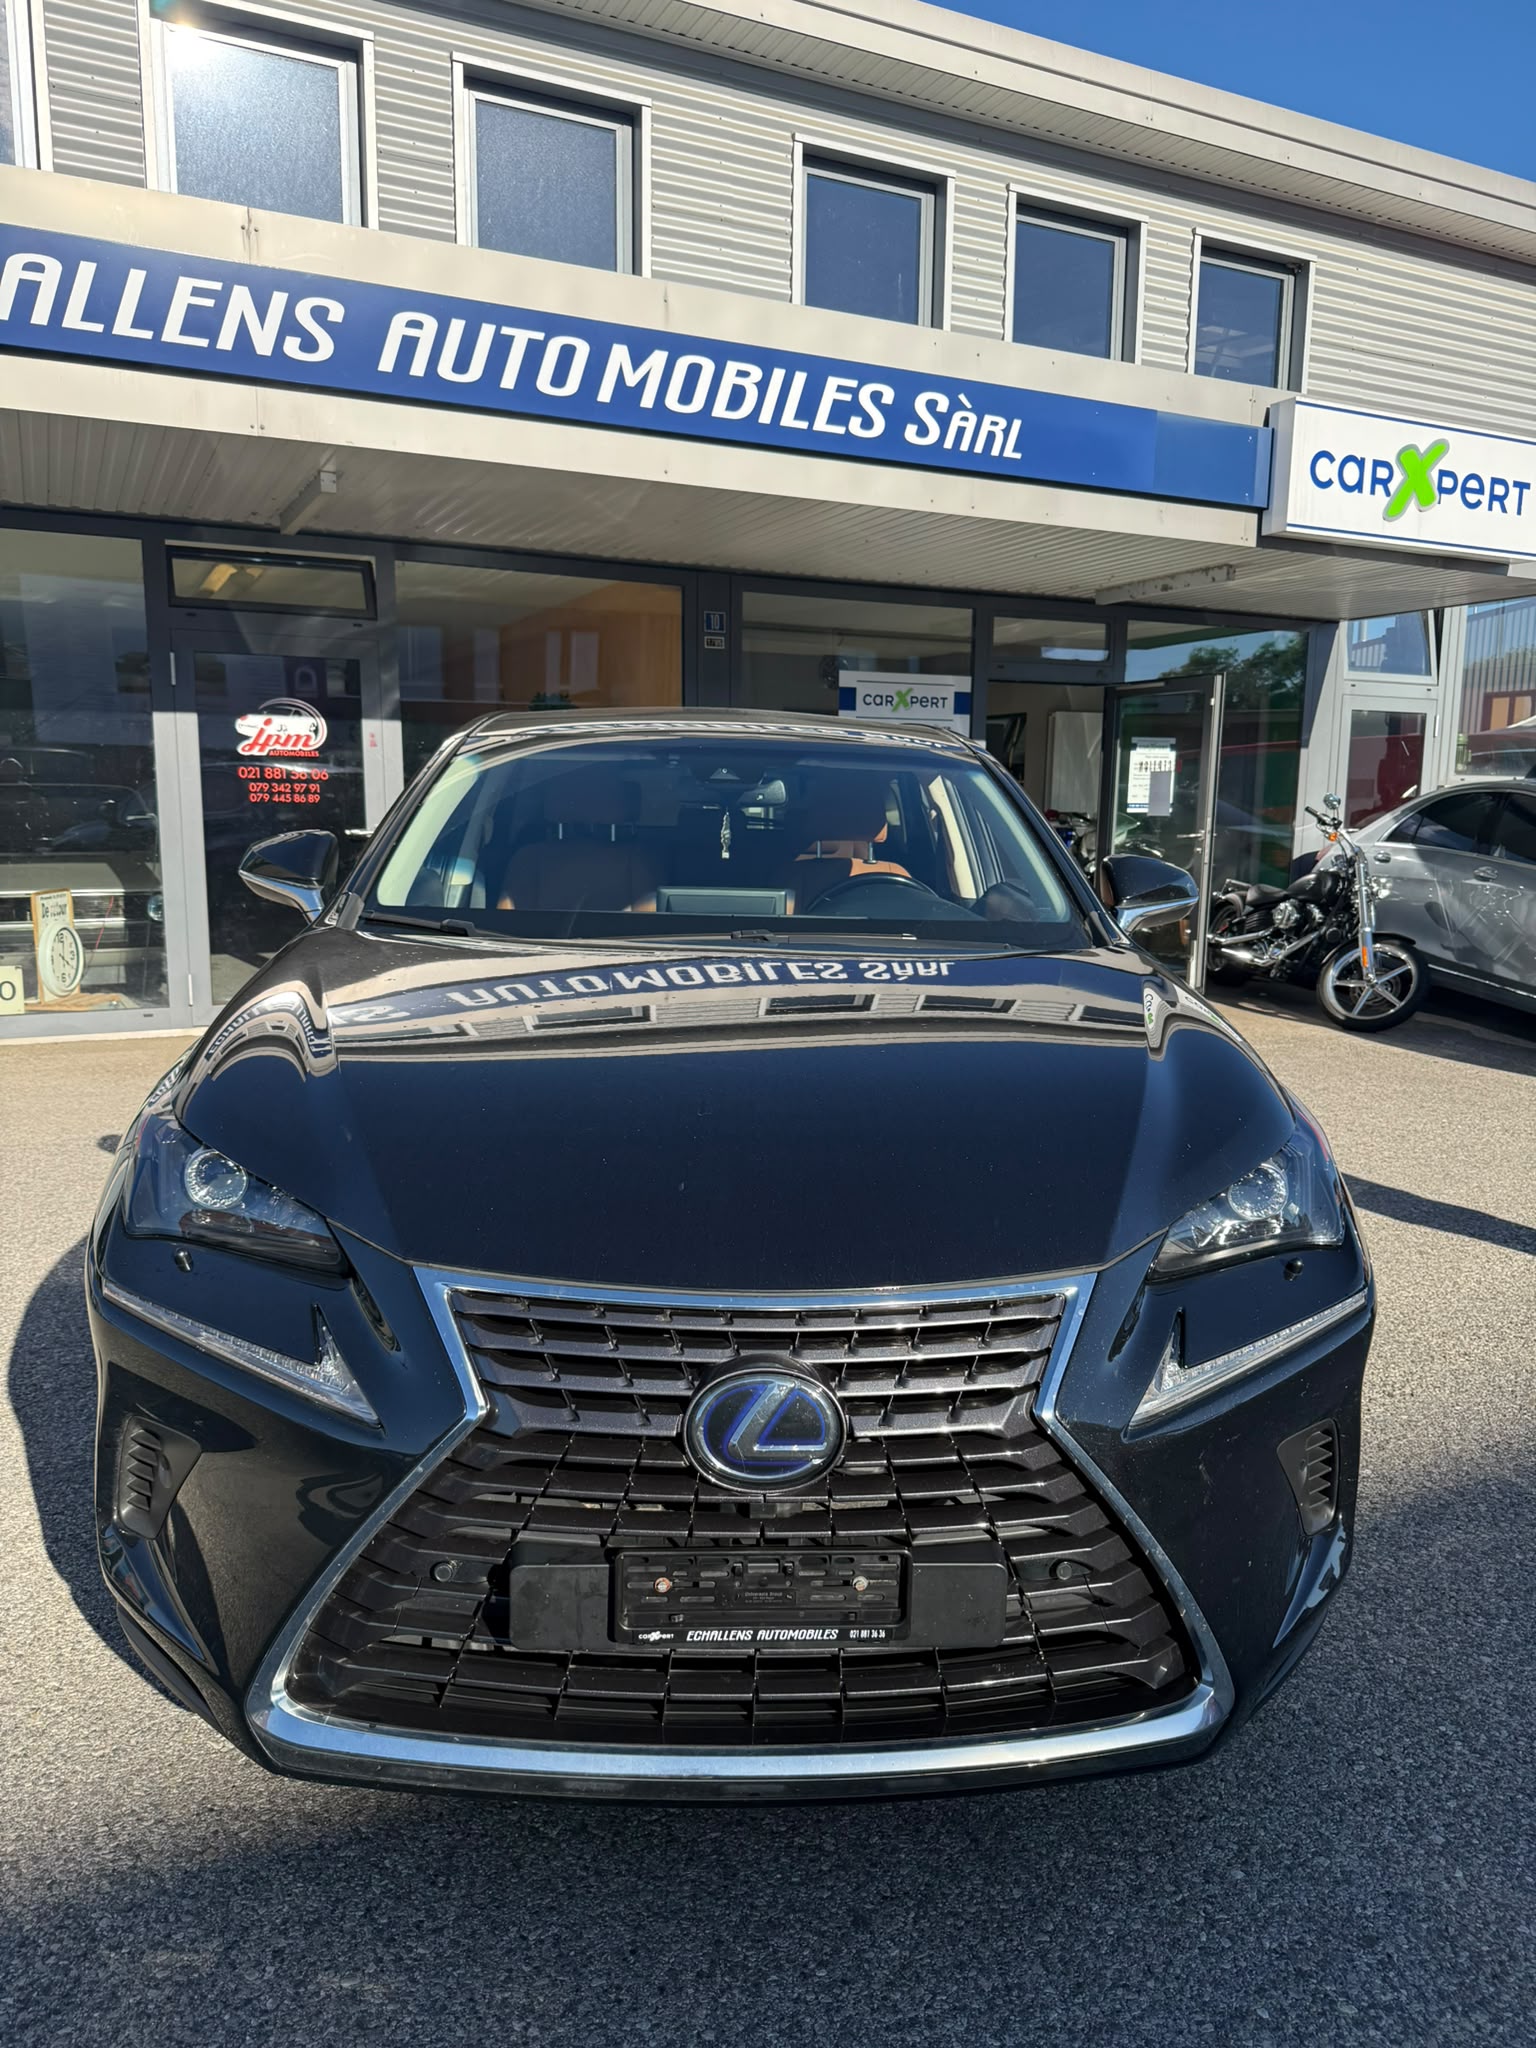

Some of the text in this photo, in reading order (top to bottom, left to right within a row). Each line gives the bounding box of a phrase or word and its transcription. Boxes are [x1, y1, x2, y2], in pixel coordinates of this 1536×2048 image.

[377, 311, 895, 439] AUTOMOBILES
[268, 749, 319, 758] AUTOMOBILES
[238, 766, 260, 779] 021
[264, 767, 286, 779] 881
[311, 768, 329, 780] 06
[248, 783, 321, 793] 079 342 97 91
[249, 793, 321, 804] 079 445 86 89
[686, 1629, 754, 1641] ECHALLENS
[756, 1628, 839, 1641] AUTOMOBILES
